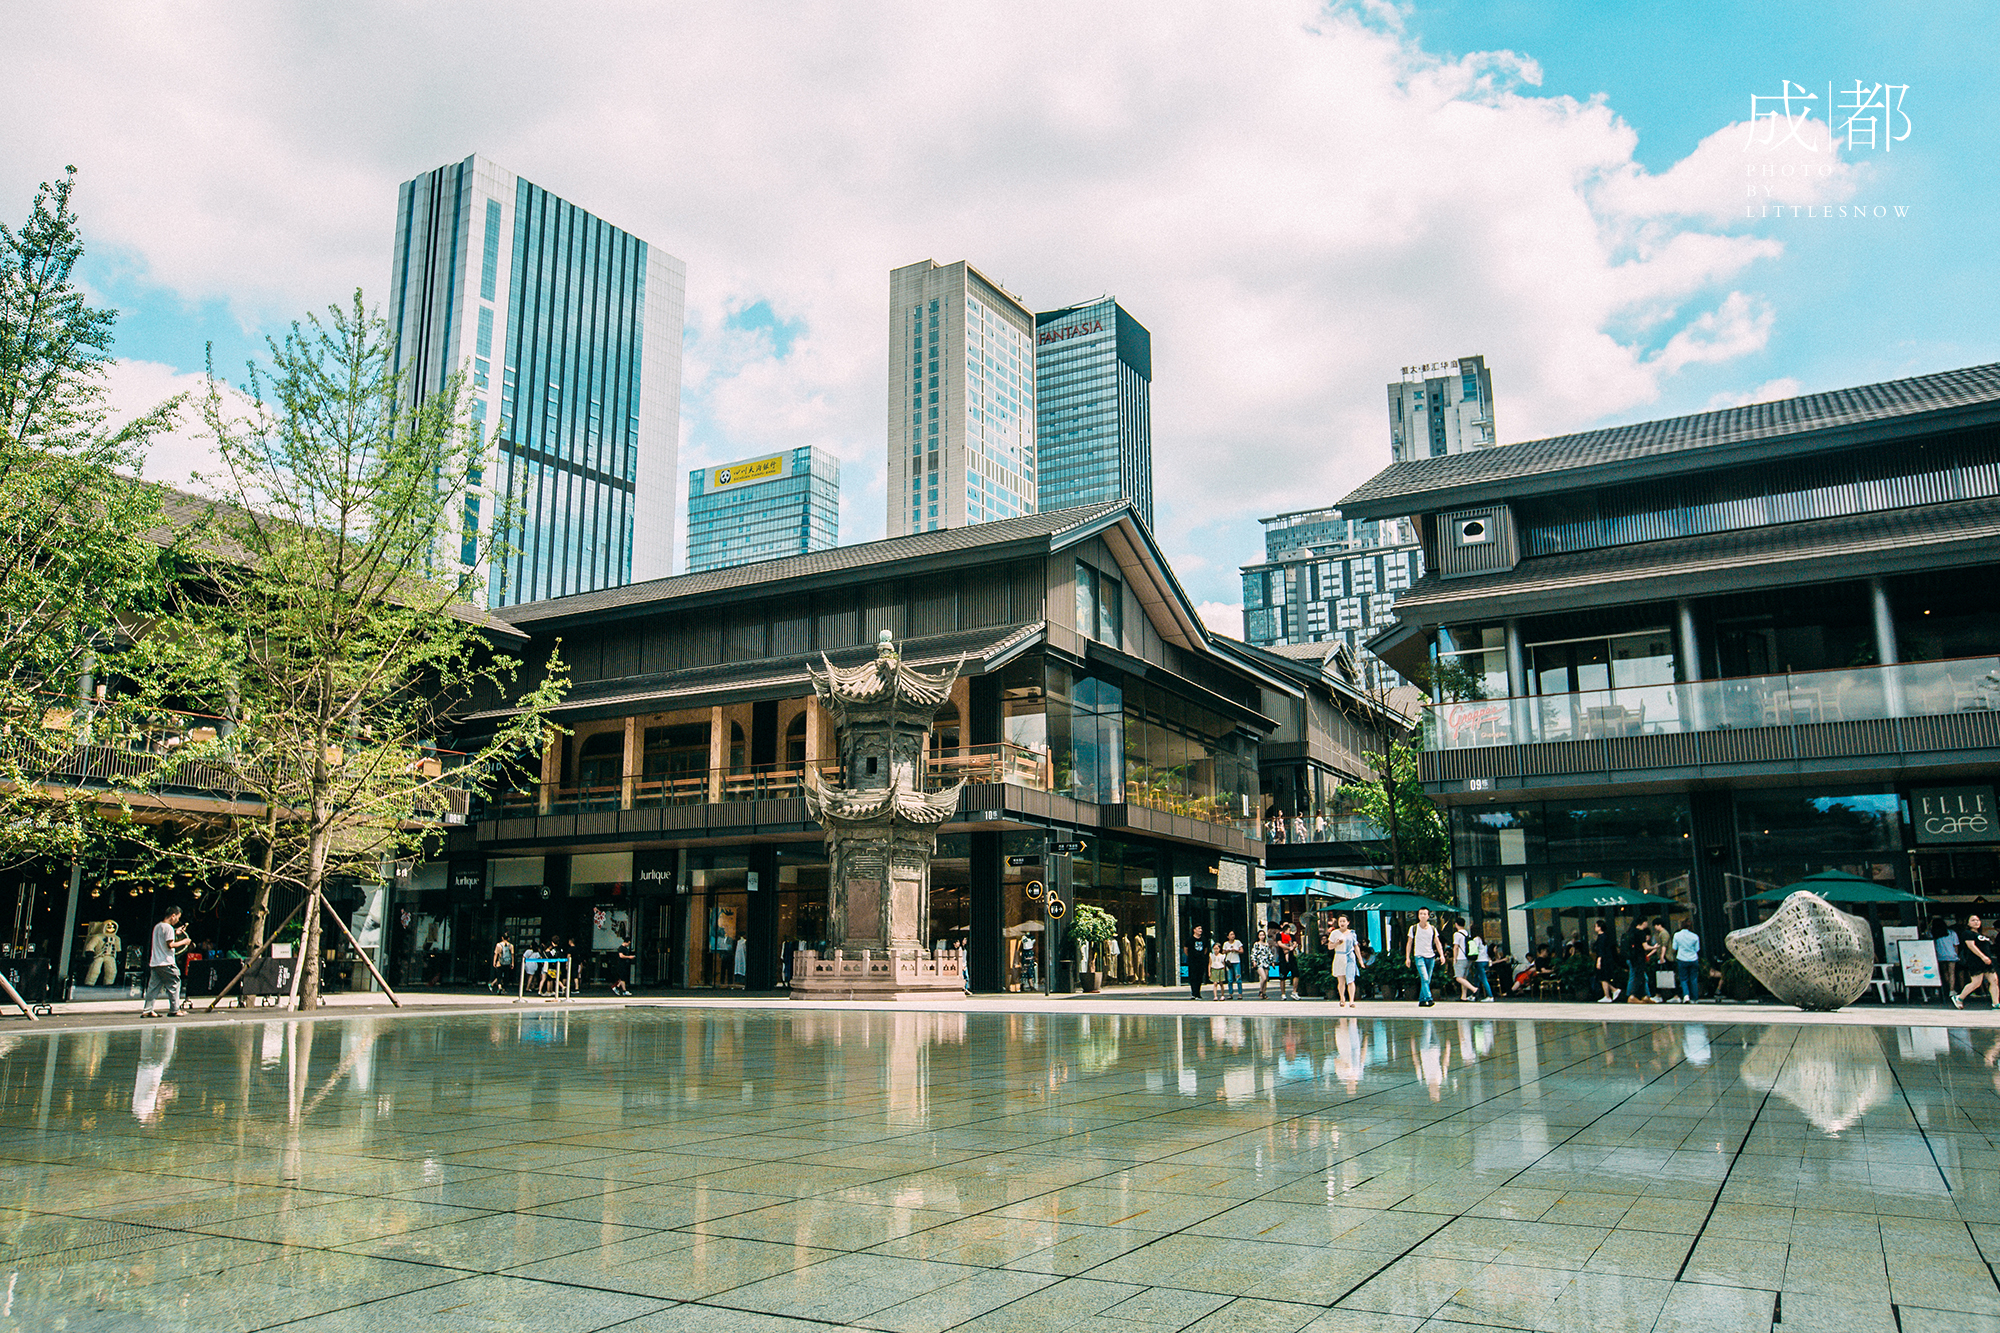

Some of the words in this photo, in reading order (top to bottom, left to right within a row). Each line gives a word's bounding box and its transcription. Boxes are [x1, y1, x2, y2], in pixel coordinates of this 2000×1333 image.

[1038, 320, 1104, 346] FANTASIA
[1922, 794, 1987, 815] ELLE
[454, 876, 480, 890] Jurlique
[639, 869, 672, 885] Jurlique
